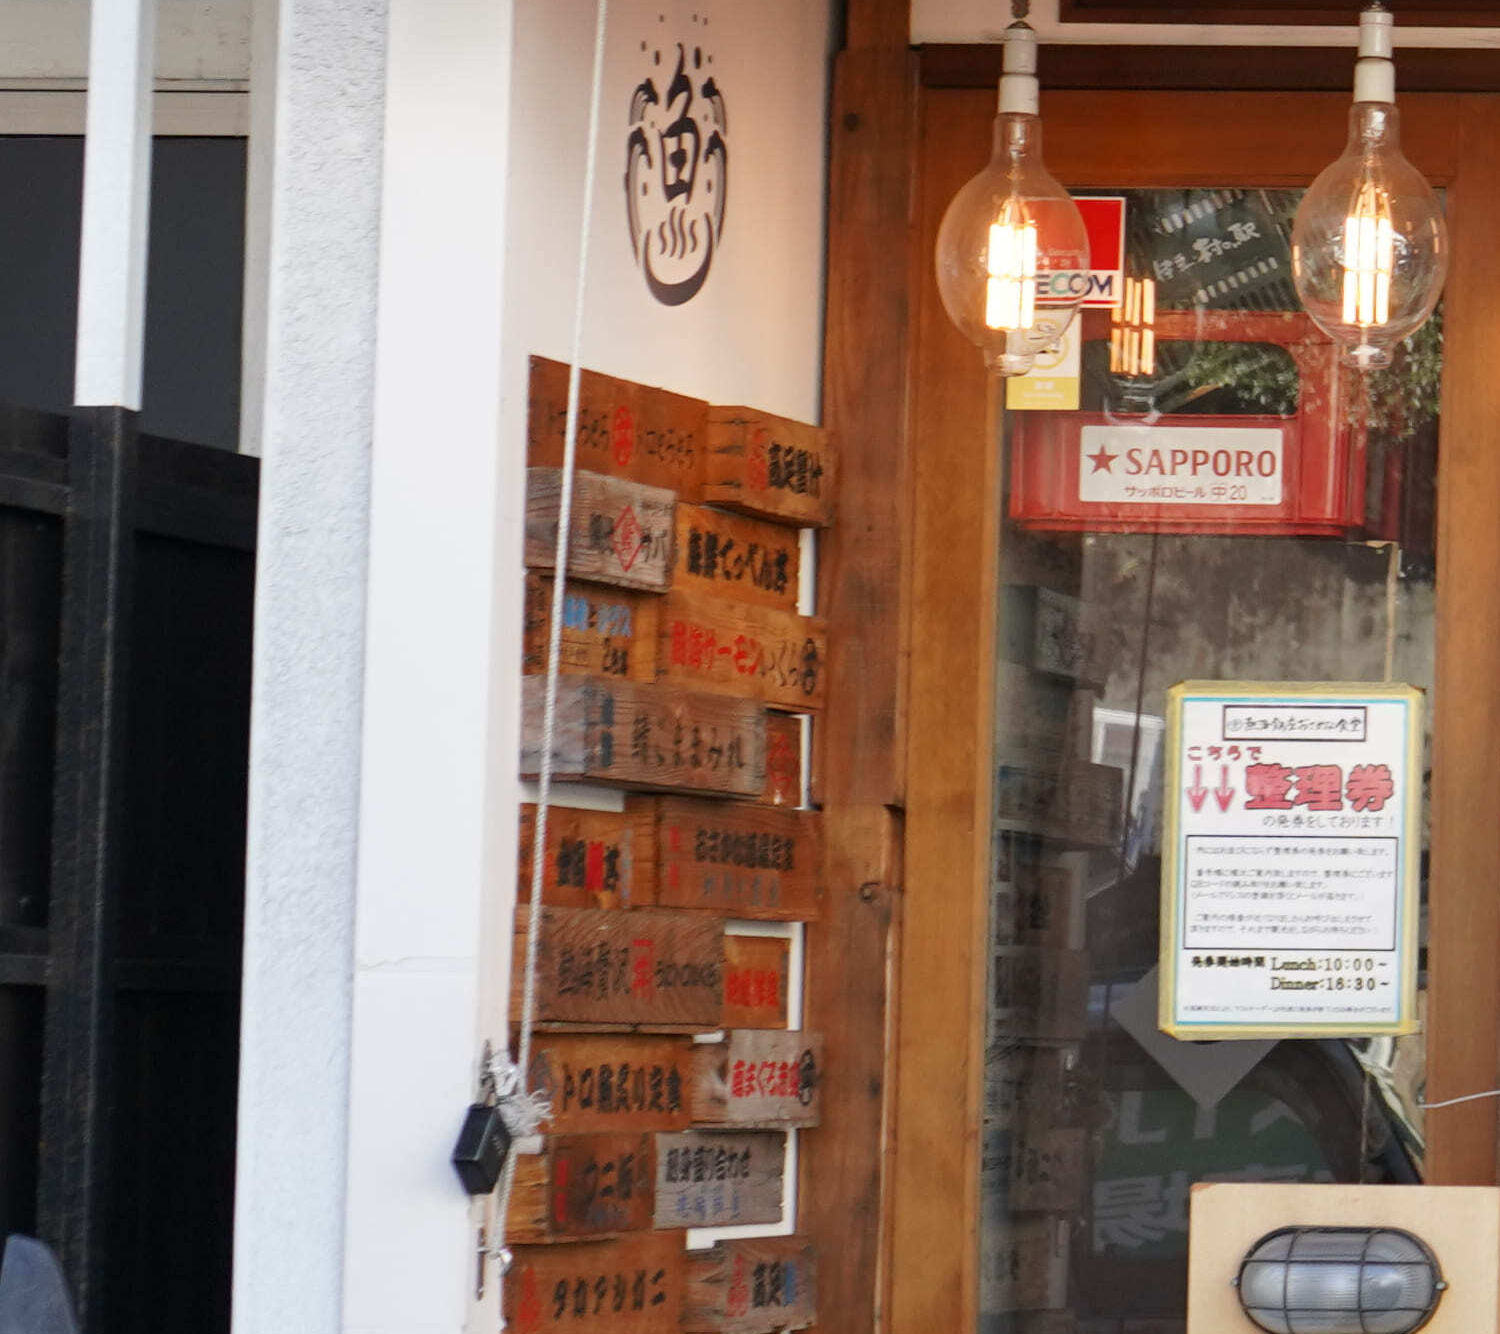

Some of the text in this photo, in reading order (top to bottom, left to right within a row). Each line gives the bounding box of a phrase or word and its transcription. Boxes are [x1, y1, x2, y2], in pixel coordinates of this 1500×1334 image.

[1125, 449, 1276, 478] SAPPORO
[1124, 484, 1206, 499] サッポロビール
[1187, 746, 1263, 761] こちらで
[1245, 762, 1394, 812] 整理券
